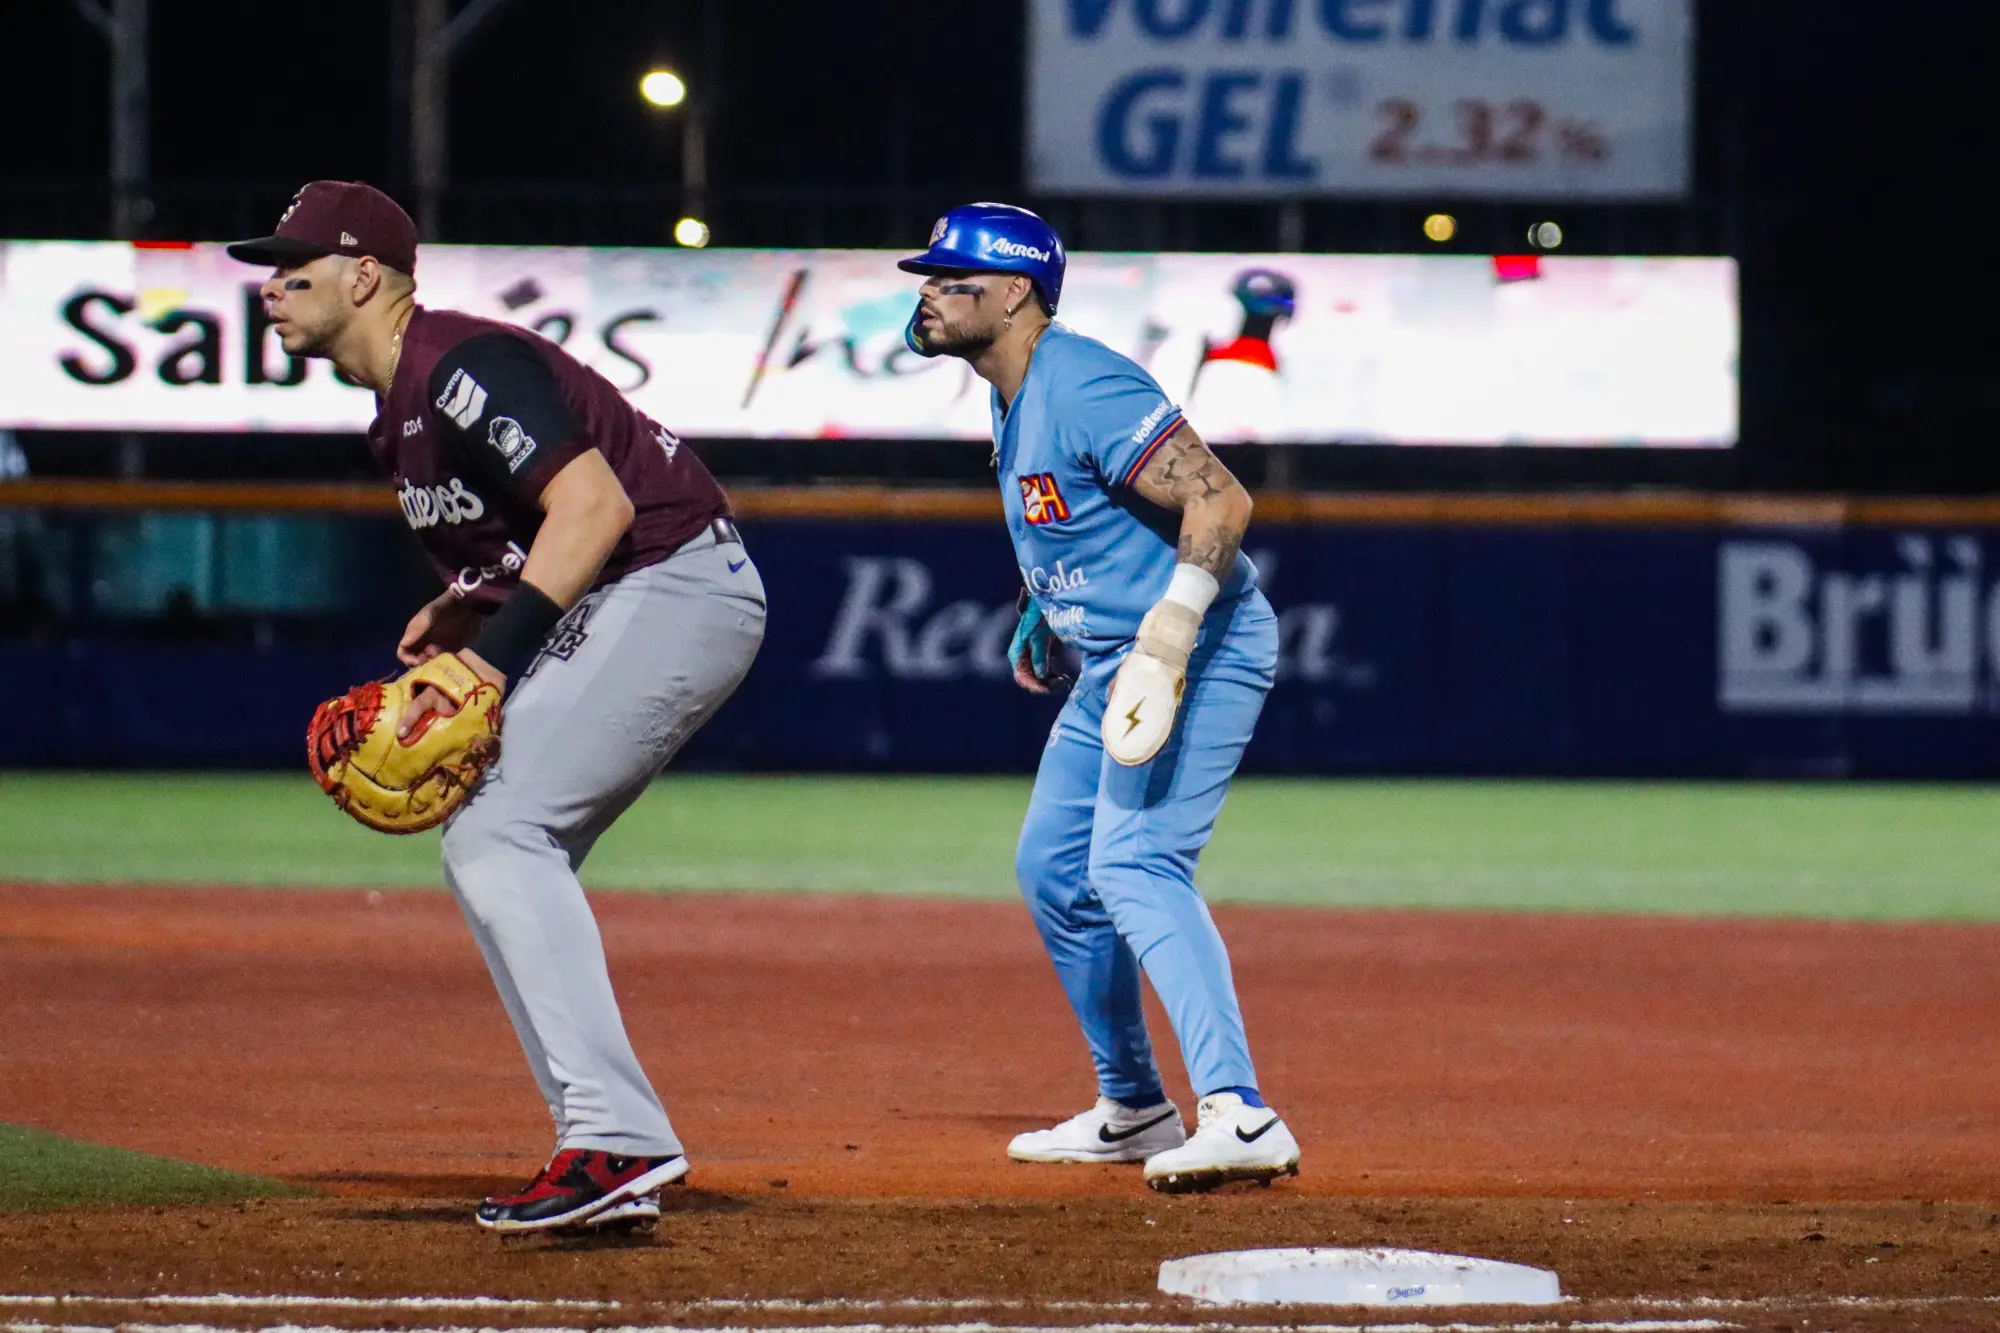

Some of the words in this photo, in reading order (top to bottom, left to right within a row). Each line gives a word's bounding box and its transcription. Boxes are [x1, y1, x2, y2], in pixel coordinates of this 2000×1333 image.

[1097, 67, 1320, 182] GEL
[986, 236, 1051, 264] AKRON
[435, 367, 465, 408] Chevron
[1715, 533, 2000, 706] Brü
